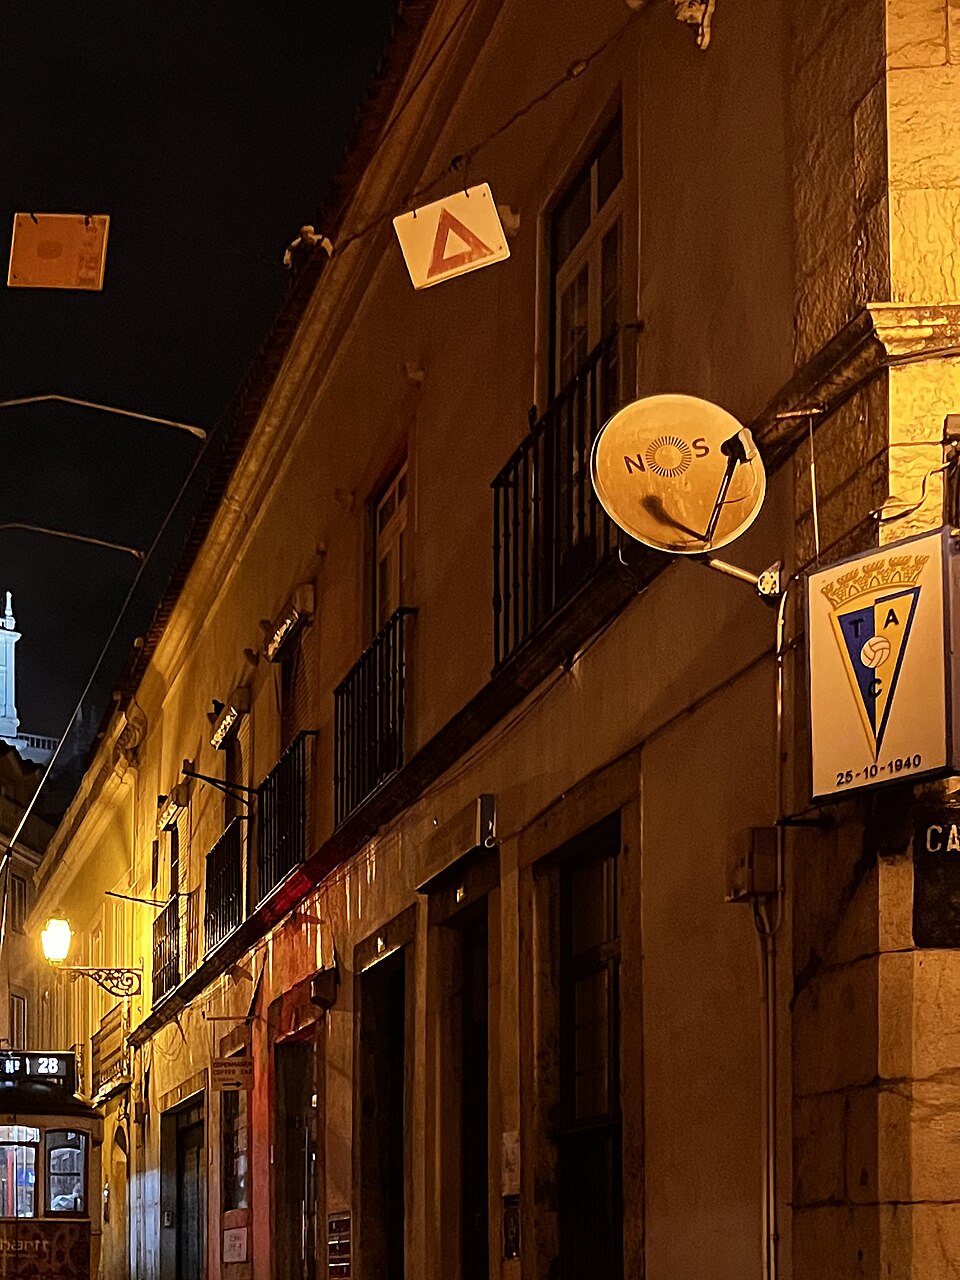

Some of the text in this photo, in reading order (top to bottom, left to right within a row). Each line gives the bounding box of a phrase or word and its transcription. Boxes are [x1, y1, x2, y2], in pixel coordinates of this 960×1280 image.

[623, 435, 710, 478] NOS
[849, 608, 900, 638] T A
[868, 678, 883, 698] C
[836, 754, 922, 787] 25-10-1940
[37, 1057, 59, 1074] 28
